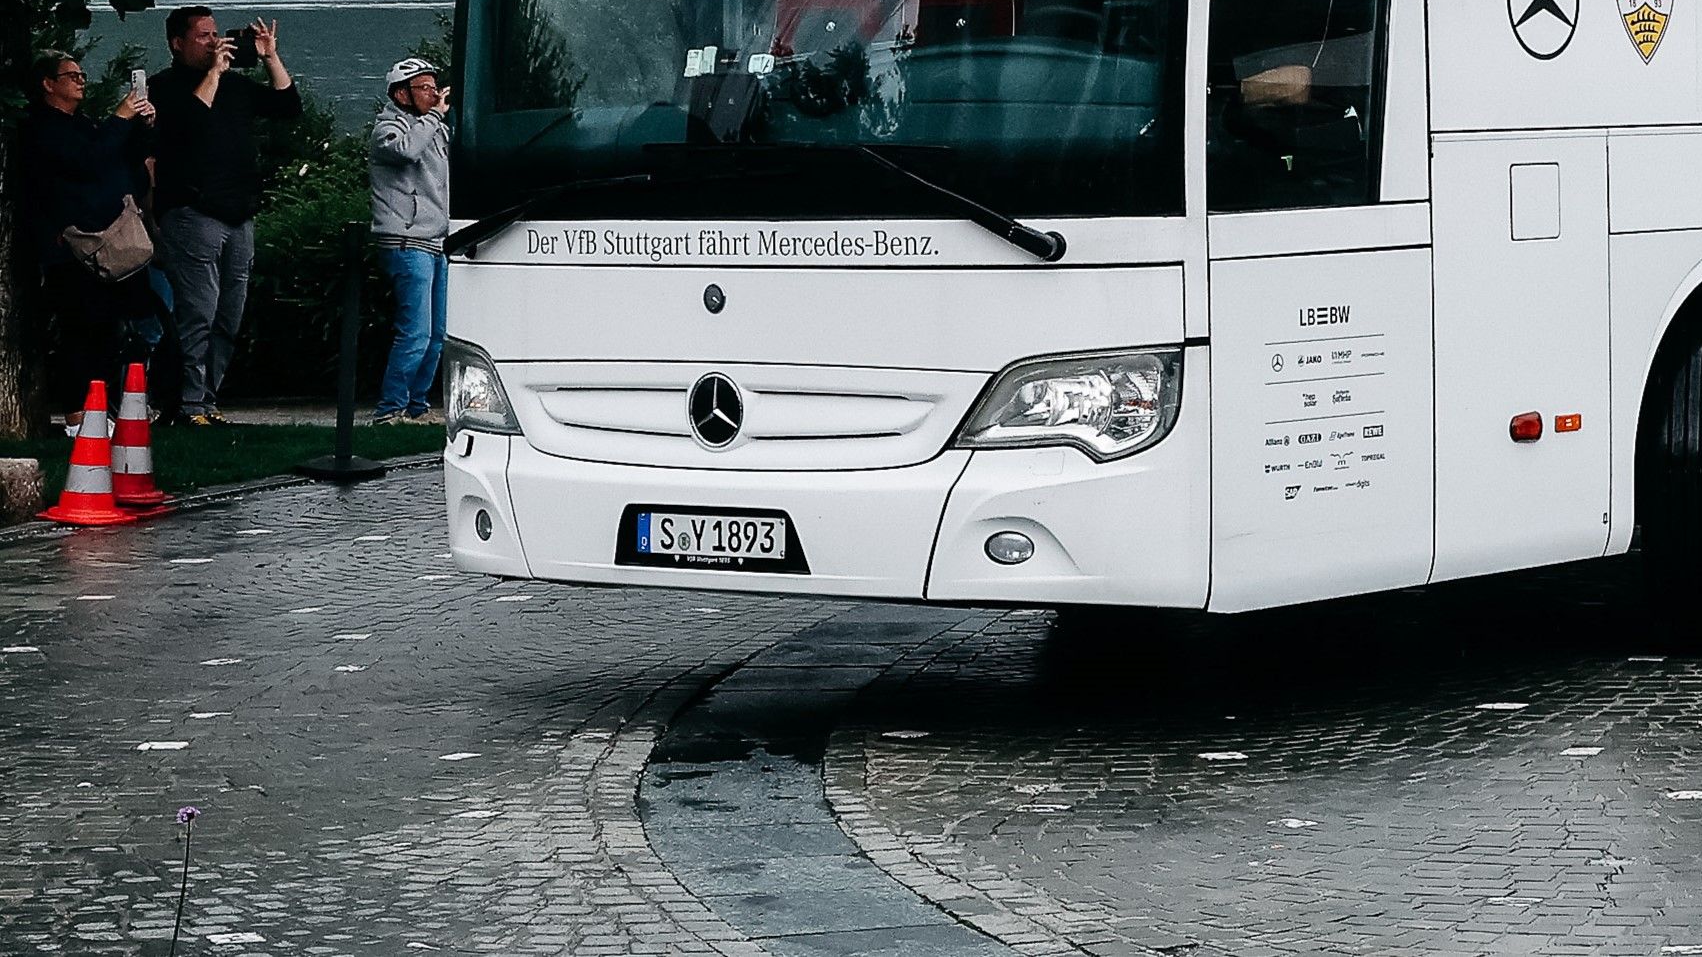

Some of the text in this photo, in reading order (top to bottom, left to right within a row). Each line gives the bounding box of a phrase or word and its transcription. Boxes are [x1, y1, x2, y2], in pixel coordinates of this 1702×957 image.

[527, 228, 939, 262] Der VfB Stuttgart fährt Mercedes-Benz.
